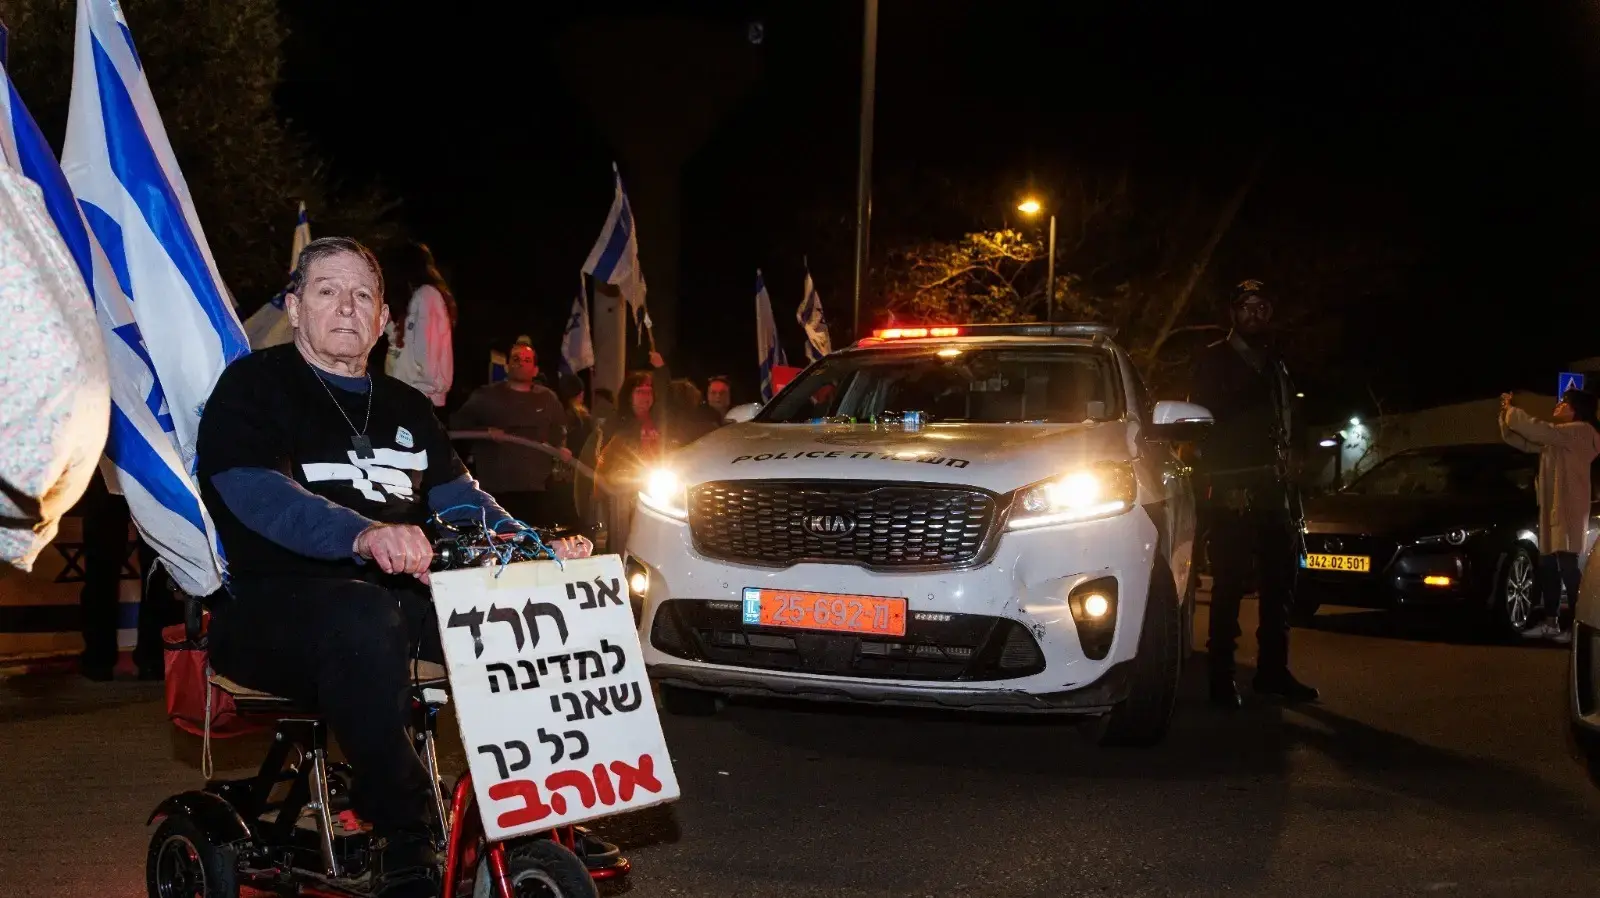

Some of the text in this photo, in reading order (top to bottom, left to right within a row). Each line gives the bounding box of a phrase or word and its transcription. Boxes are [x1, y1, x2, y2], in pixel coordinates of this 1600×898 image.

[731, 451, 844, 464] POLICE
[850, 451, 970, 468] משרה
[811, 515, 846, 531] KIA
[566, 576, 624, 610] אני
[447, 597, 569, 659] חרד
[486, 639, 626, 693] למדינה
[550, 681, 642, 722] שאני
[477, 728, 589, 779] כל כך
[488, 753, 662, 828] אוהב
